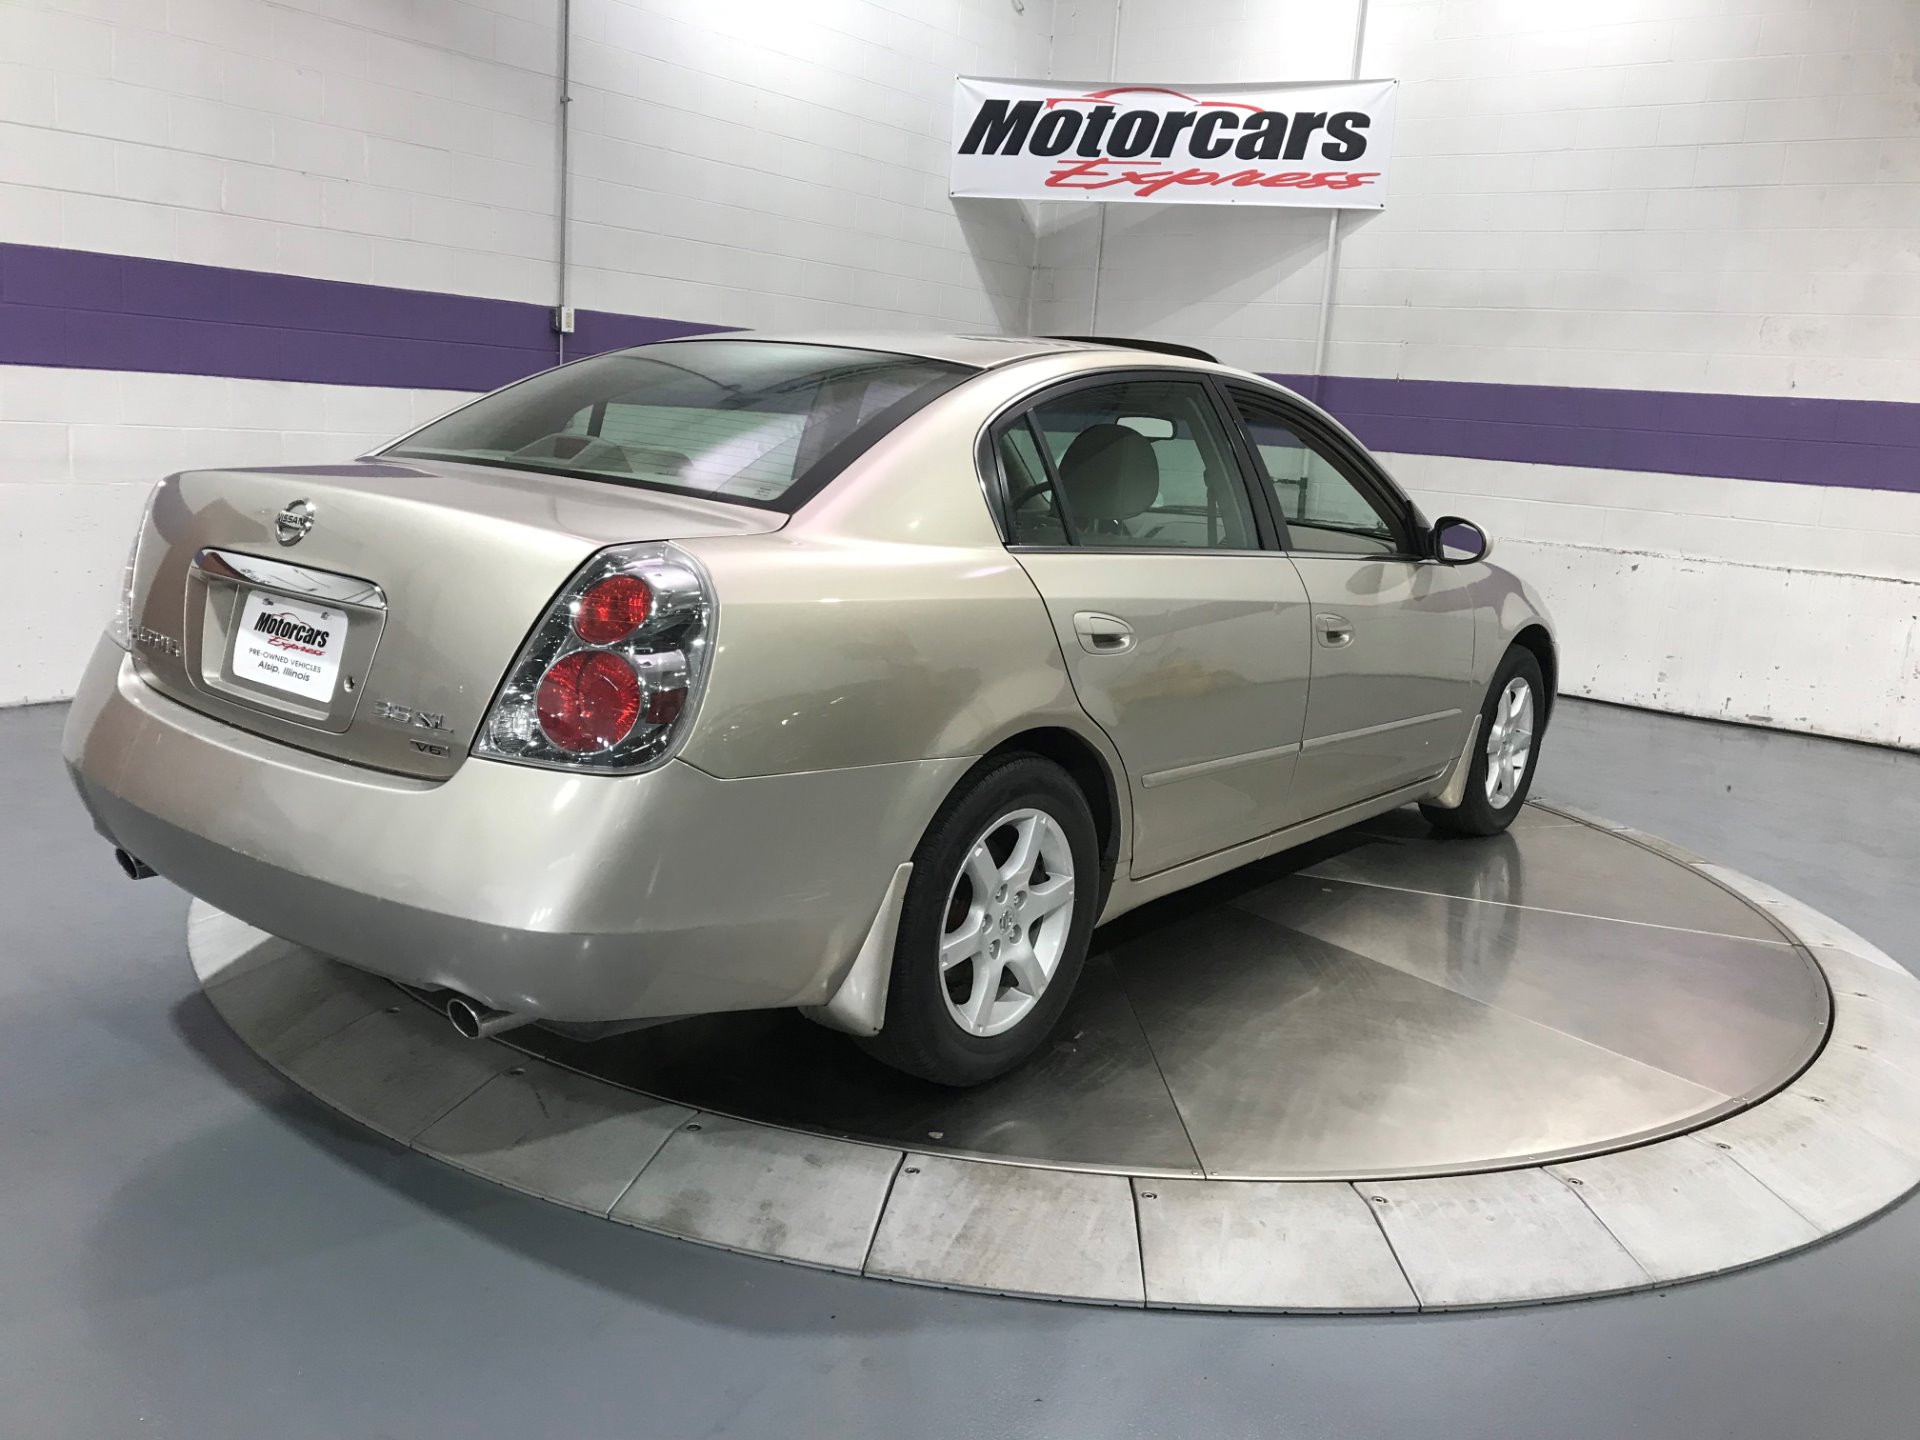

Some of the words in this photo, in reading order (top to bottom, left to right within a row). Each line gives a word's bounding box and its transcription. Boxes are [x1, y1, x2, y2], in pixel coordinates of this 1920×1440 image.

[957, 98, 1371, 162] Motorcars
[1044, 157, 1381, 197] Express
[279, 512, 305, 526] NISSAN
[253, 611, 330, 648] Motorcars
[267, 636, 326, 656] Express
[248, 647, 289, 664] PRE-OWNED
[290, 658, 322, 673] VEHICLES
[257, 660, 280, 675] Alsip,
[282, 667, 311, 682] Illinois
[414, 742, 441, 756] V6
